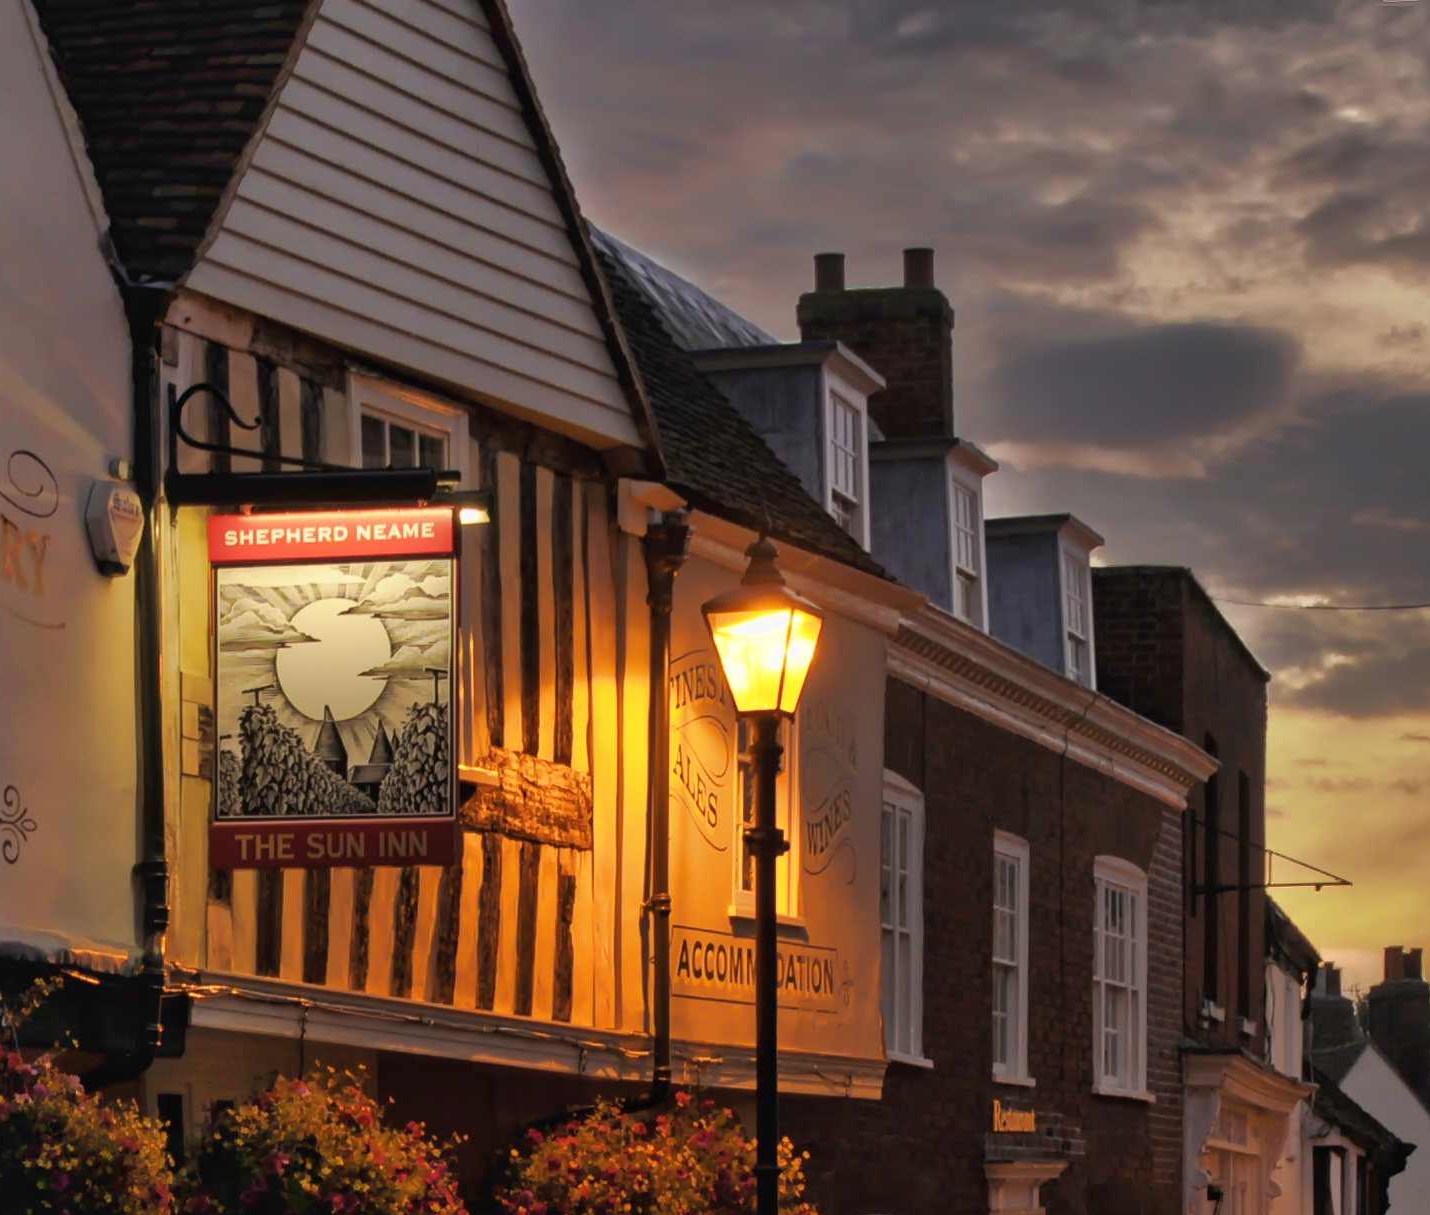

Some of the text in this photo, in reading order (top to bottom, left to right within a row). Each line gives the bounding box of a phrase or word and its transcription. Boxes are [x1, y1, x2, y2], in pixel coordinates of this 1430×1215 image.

[224, 521, 436, 547] SHEPHERD NEAME
[673, 744, 717, 828] ALES
[234, 829, 428, 862] THE SUN INN
[806, 790, 851, 857] WINES
[677, 938, 834, 995] ACCOMMDATION
